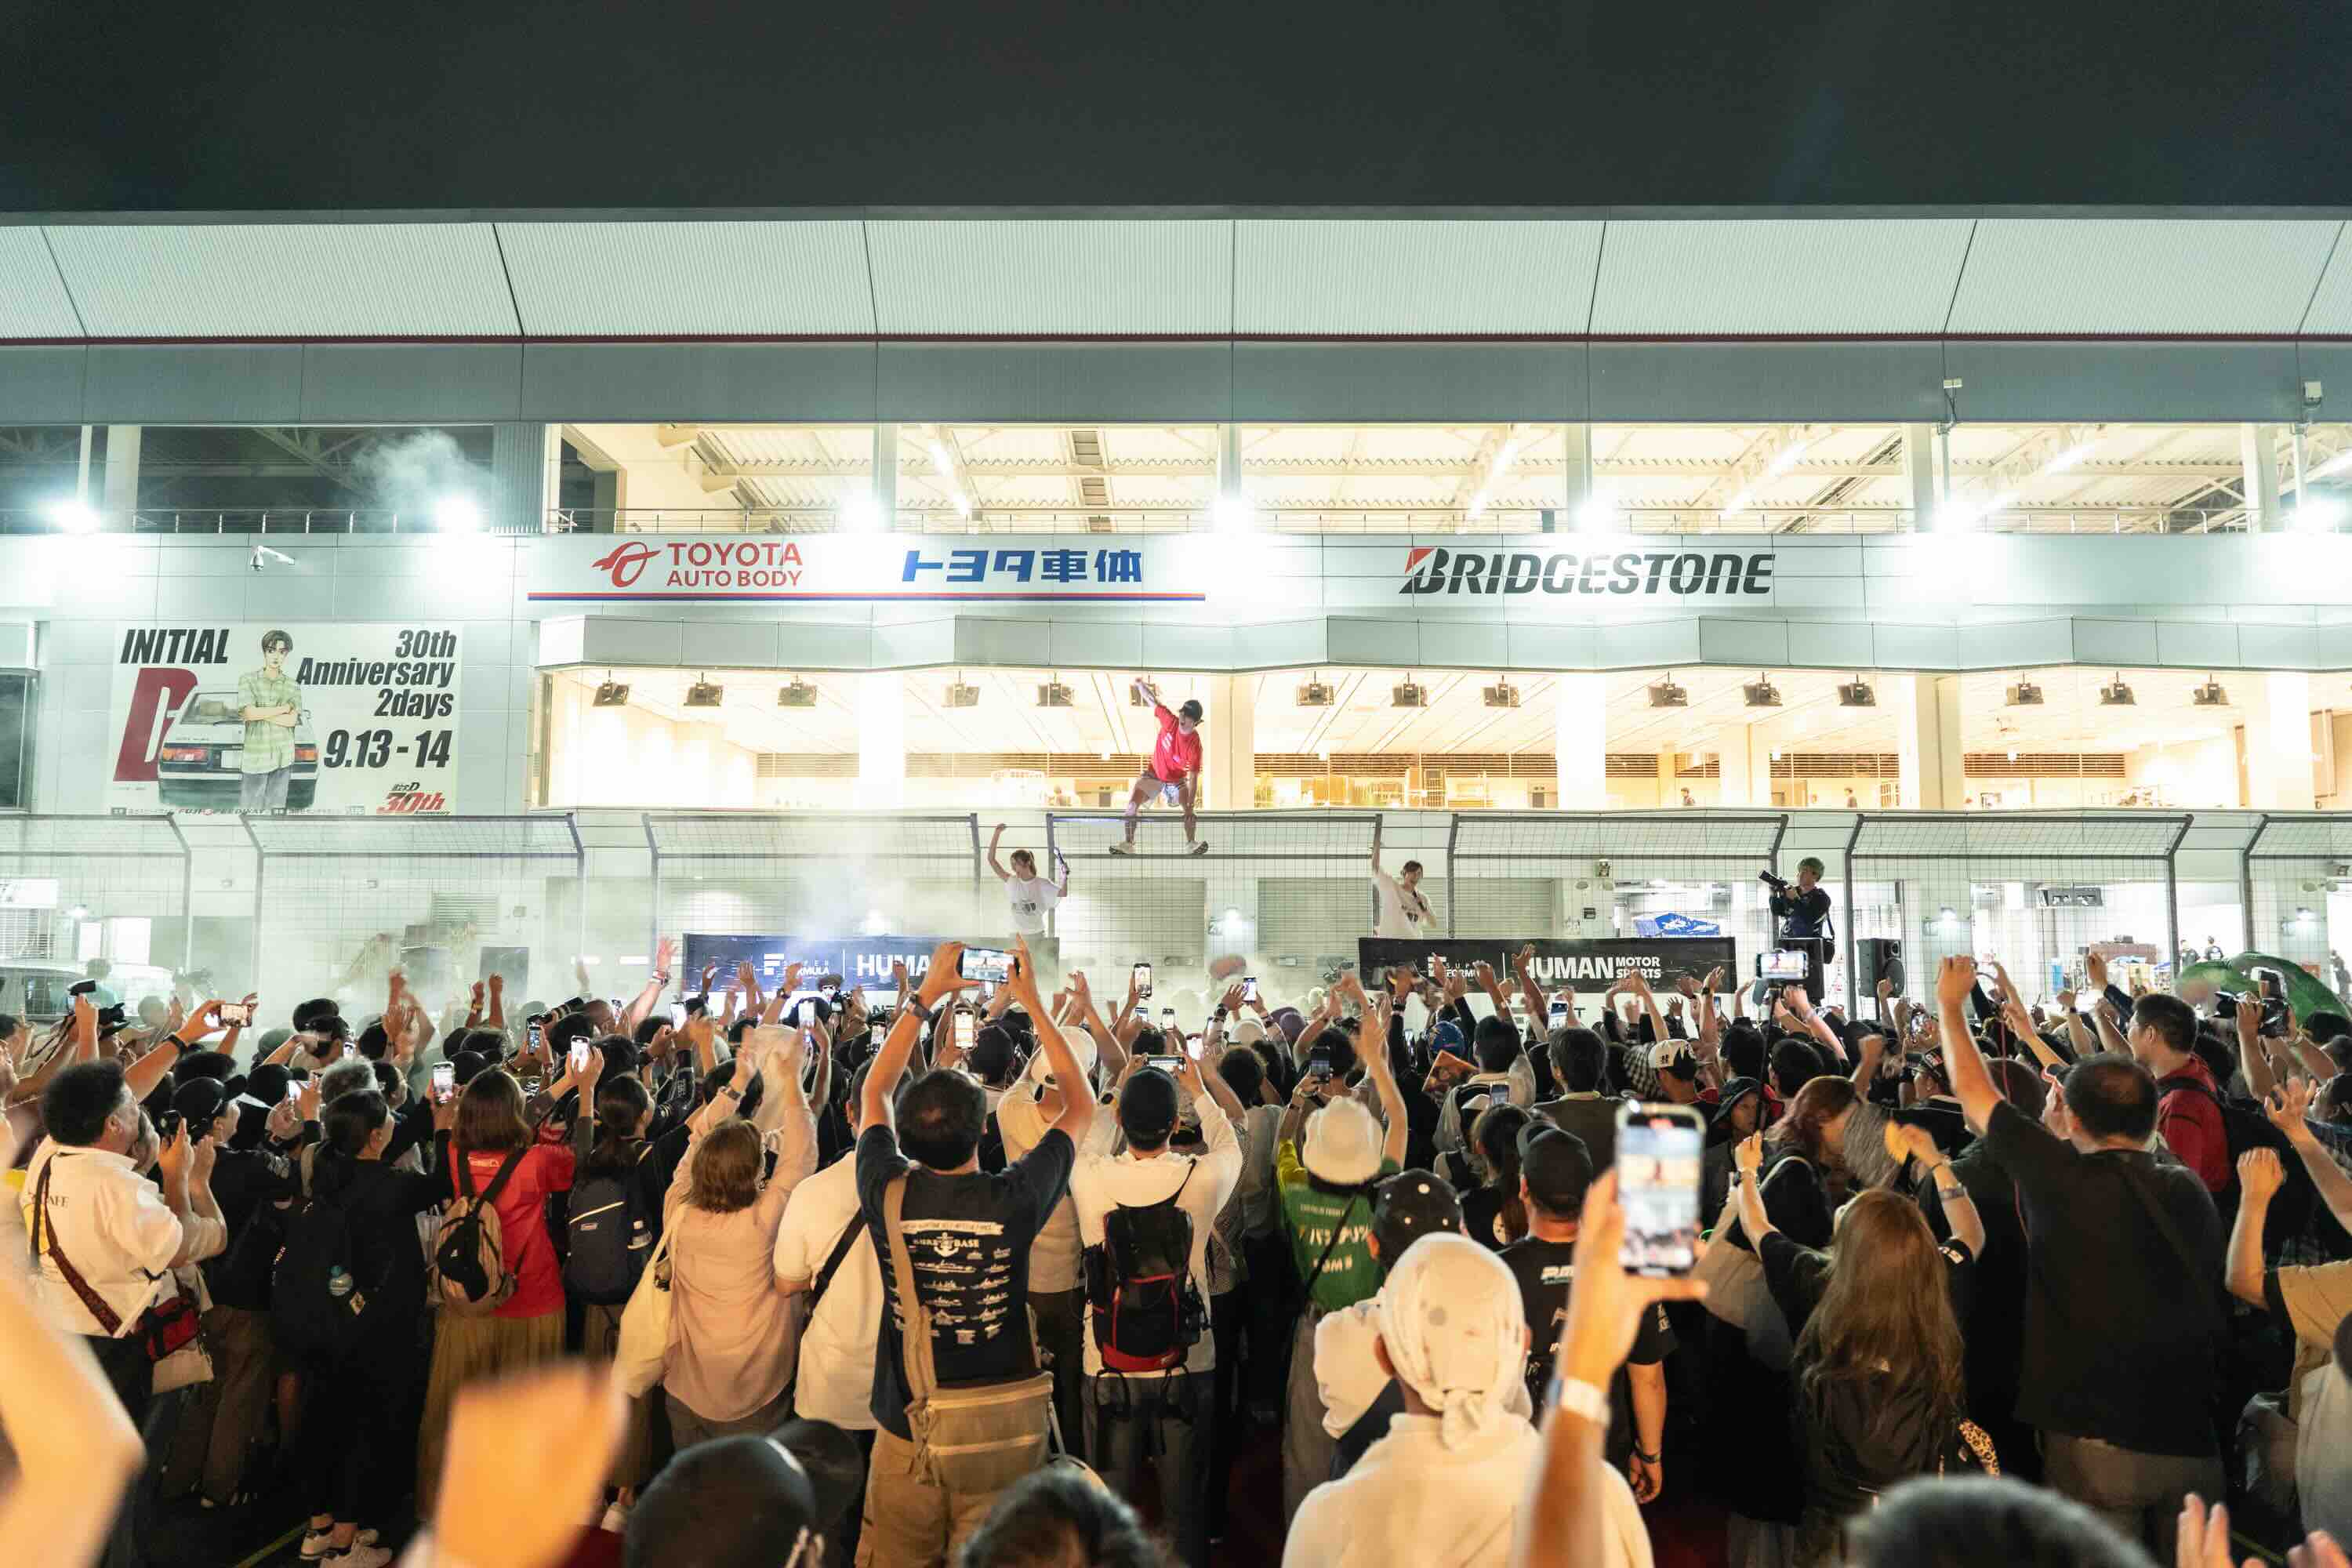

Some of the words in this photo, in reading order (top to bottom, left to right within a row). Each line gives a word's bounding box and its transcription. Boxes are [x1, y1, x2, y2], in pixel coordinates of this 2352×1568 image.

[667, 543, 803, 566] TOYOTA
[902, 549, 1142, 583] トヨタ車体
[666, 570, 731, 586] AUTO
[737, 570, 802, 586] BODY
[1399, 548, 1776, 594] BRIDGESTONE
[120, 629, 229, 664] INITIAL
[394, 630, 457, 658] 30th
[296, 657, 455, 688] Anniversary
[374, 688, 454, 720] 2days
[857, 953, 929, 977] HUMA
[1615, 956, 1661, 967] MOTOR
